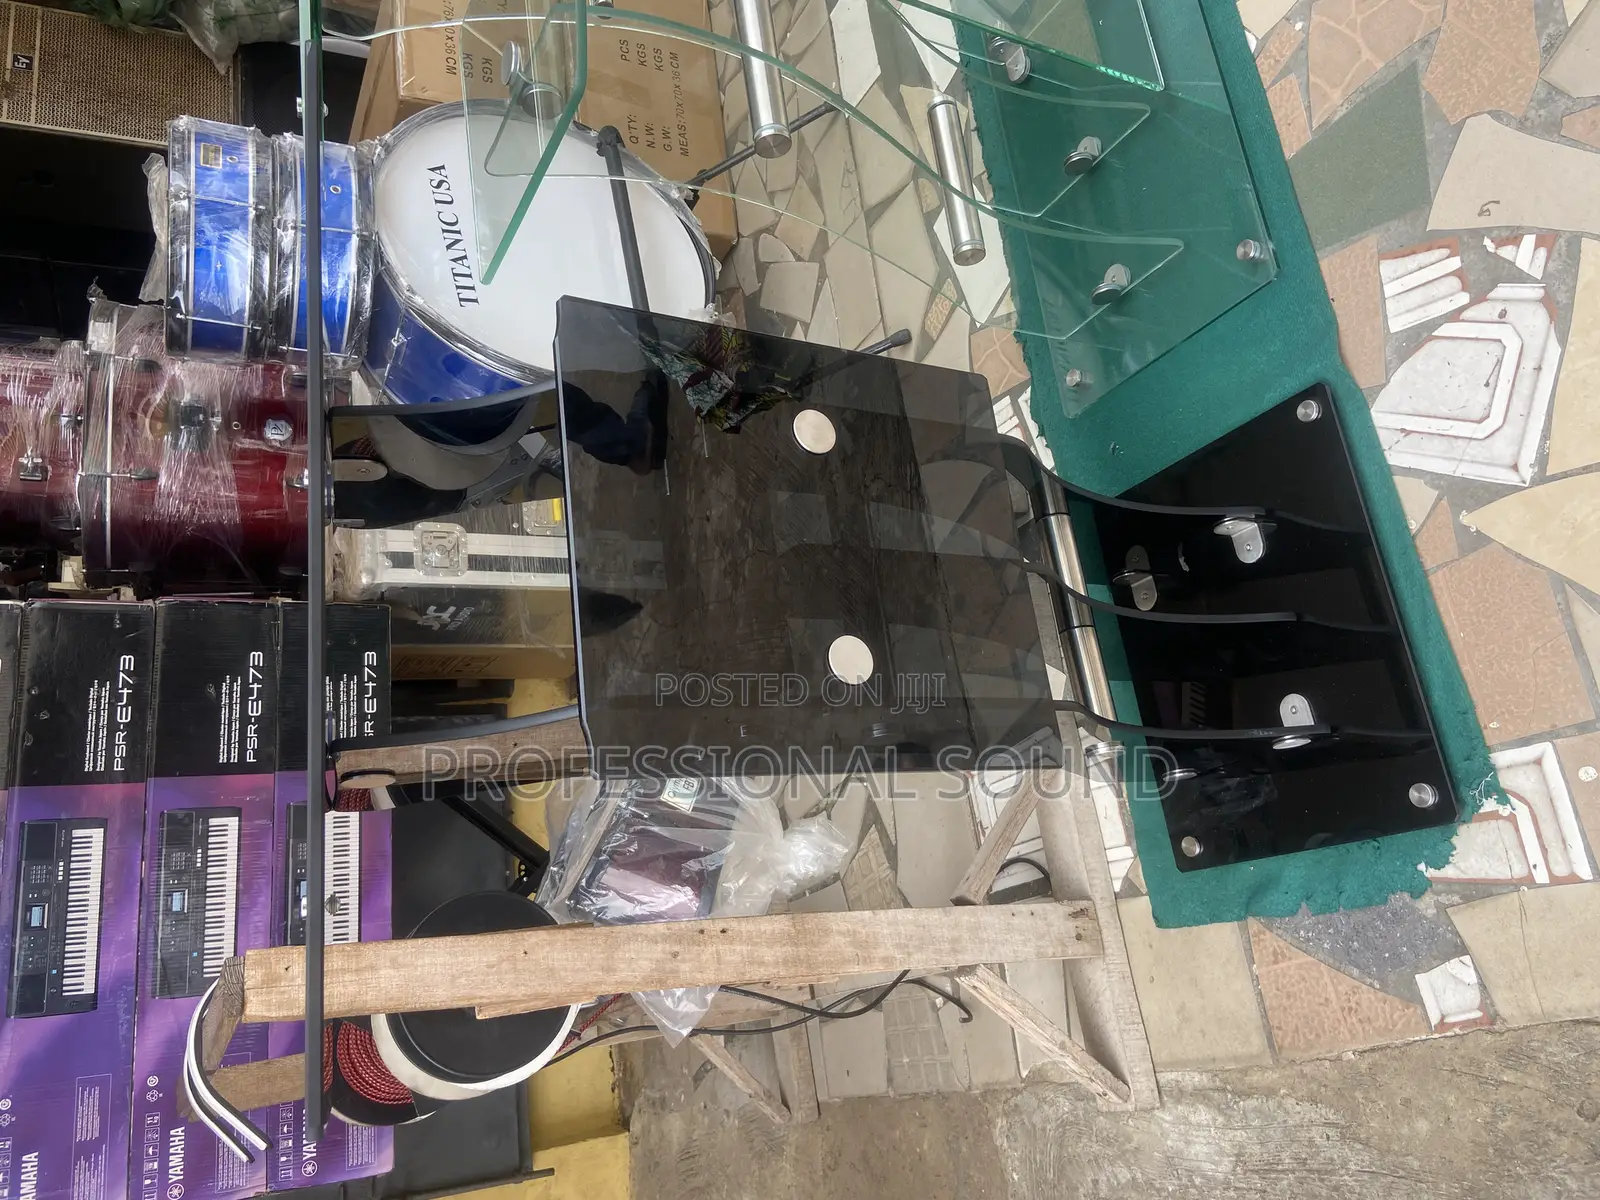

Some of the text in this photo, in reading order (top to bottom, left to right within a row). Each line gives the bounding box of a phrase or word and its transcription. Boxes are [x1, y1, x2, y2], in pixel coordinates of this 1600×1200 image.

[445, 56, 457, 76] CM
[462, 52, 474, 79] KGS
[481, 57, 493, 84] KGS
[619, 39, 639, 145] Q'TY: PCS
[636, 42, 656, 149] N.W: KGS
[653, 47, 673, 152] G.W: KGS
[669, 51, 680, 69] CM
[426, 164, 479, 308] TITANIC USA
[113, 654, 135, 771] PSR-E473
[246, 651, 264, 763] PSR-E473
[364, 651, 378, 737] R-E473
[19, 1151, 39, 1200] AMAHA
[168, 1126, 185, 1184] YAMAHA
